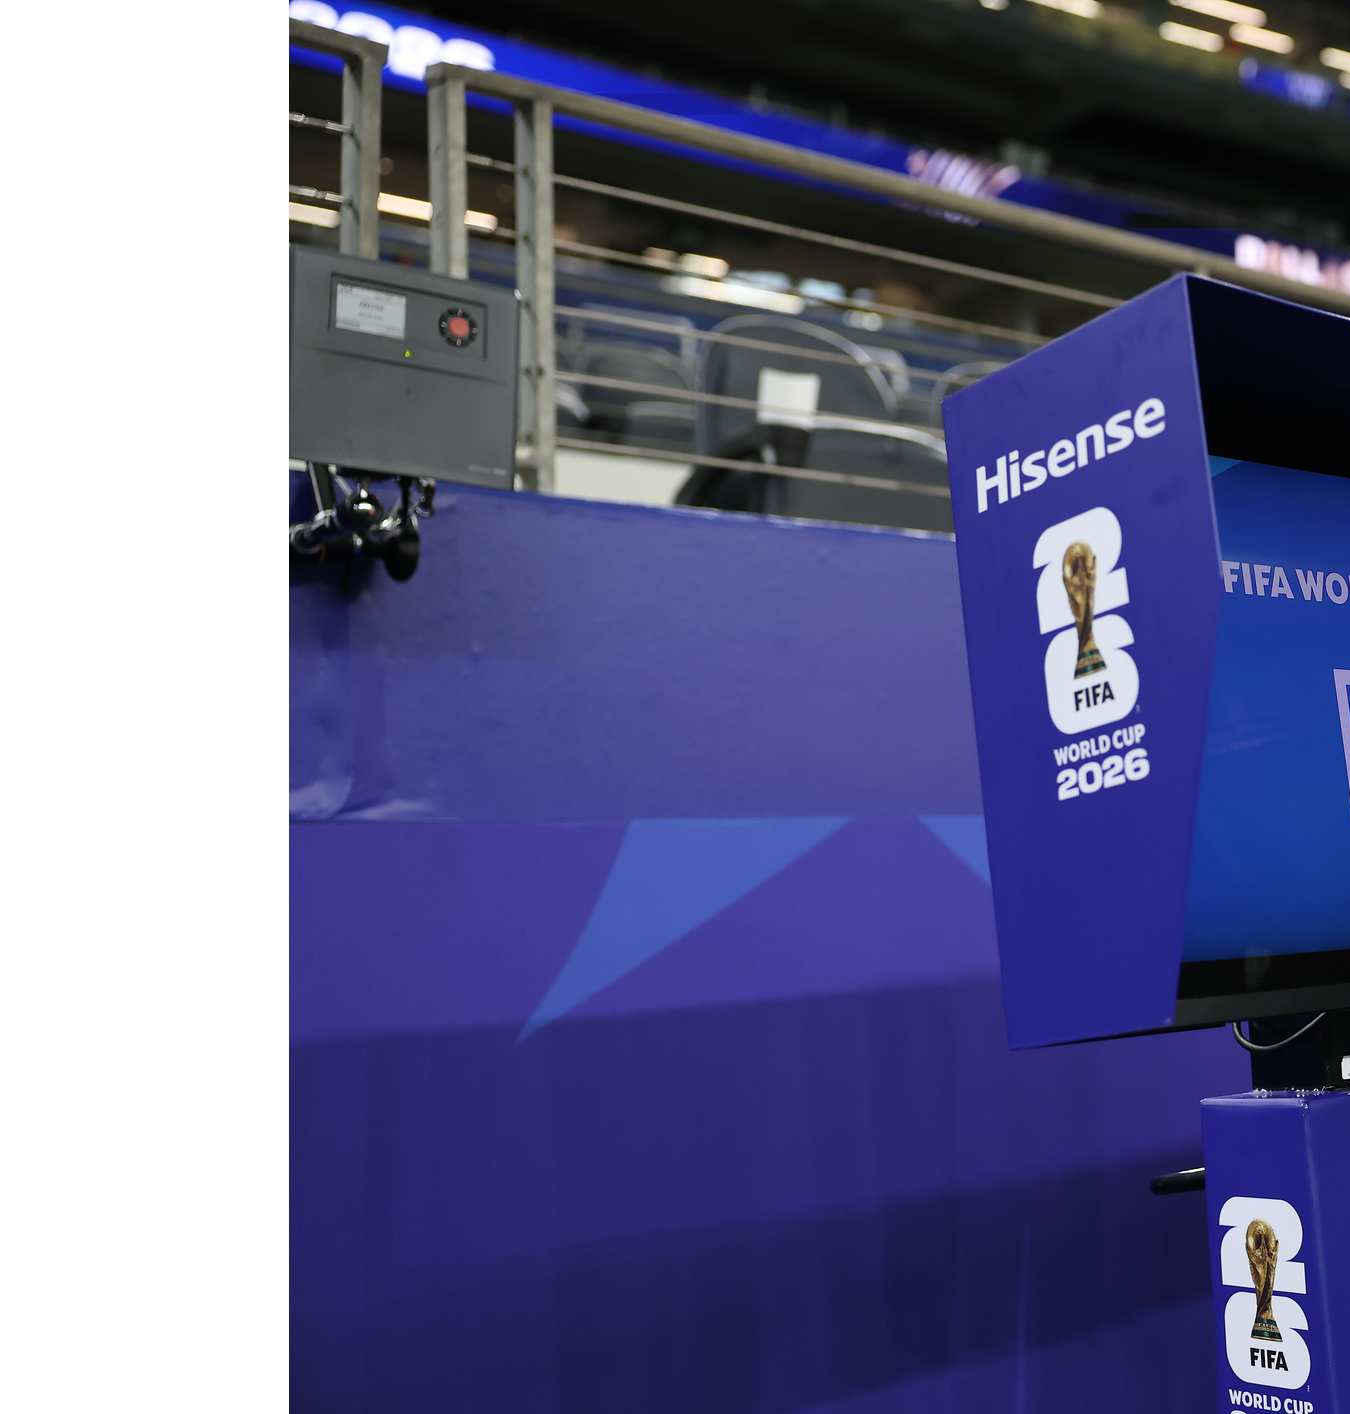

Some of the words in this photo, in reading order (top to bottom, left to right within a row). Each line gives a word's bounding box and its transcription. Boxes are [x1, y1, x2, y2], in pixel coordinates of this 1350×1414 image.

[976, 397, 1166, 514] Hisense
[1221, 560, 1295, 599] FIFA
[1074, 680, 1115, 711] FIFA
[1053, 734, 1111, 766] WORLD
[1112, 723, 1146, 750] CUP
[1056, 747, 1151, 801] 2026
[1250, 1348, 1289, 1372] FIFA
[1228, 1388, 1282, 1412] WORLD
[1283, 1398, 1314, 1414] CUP
